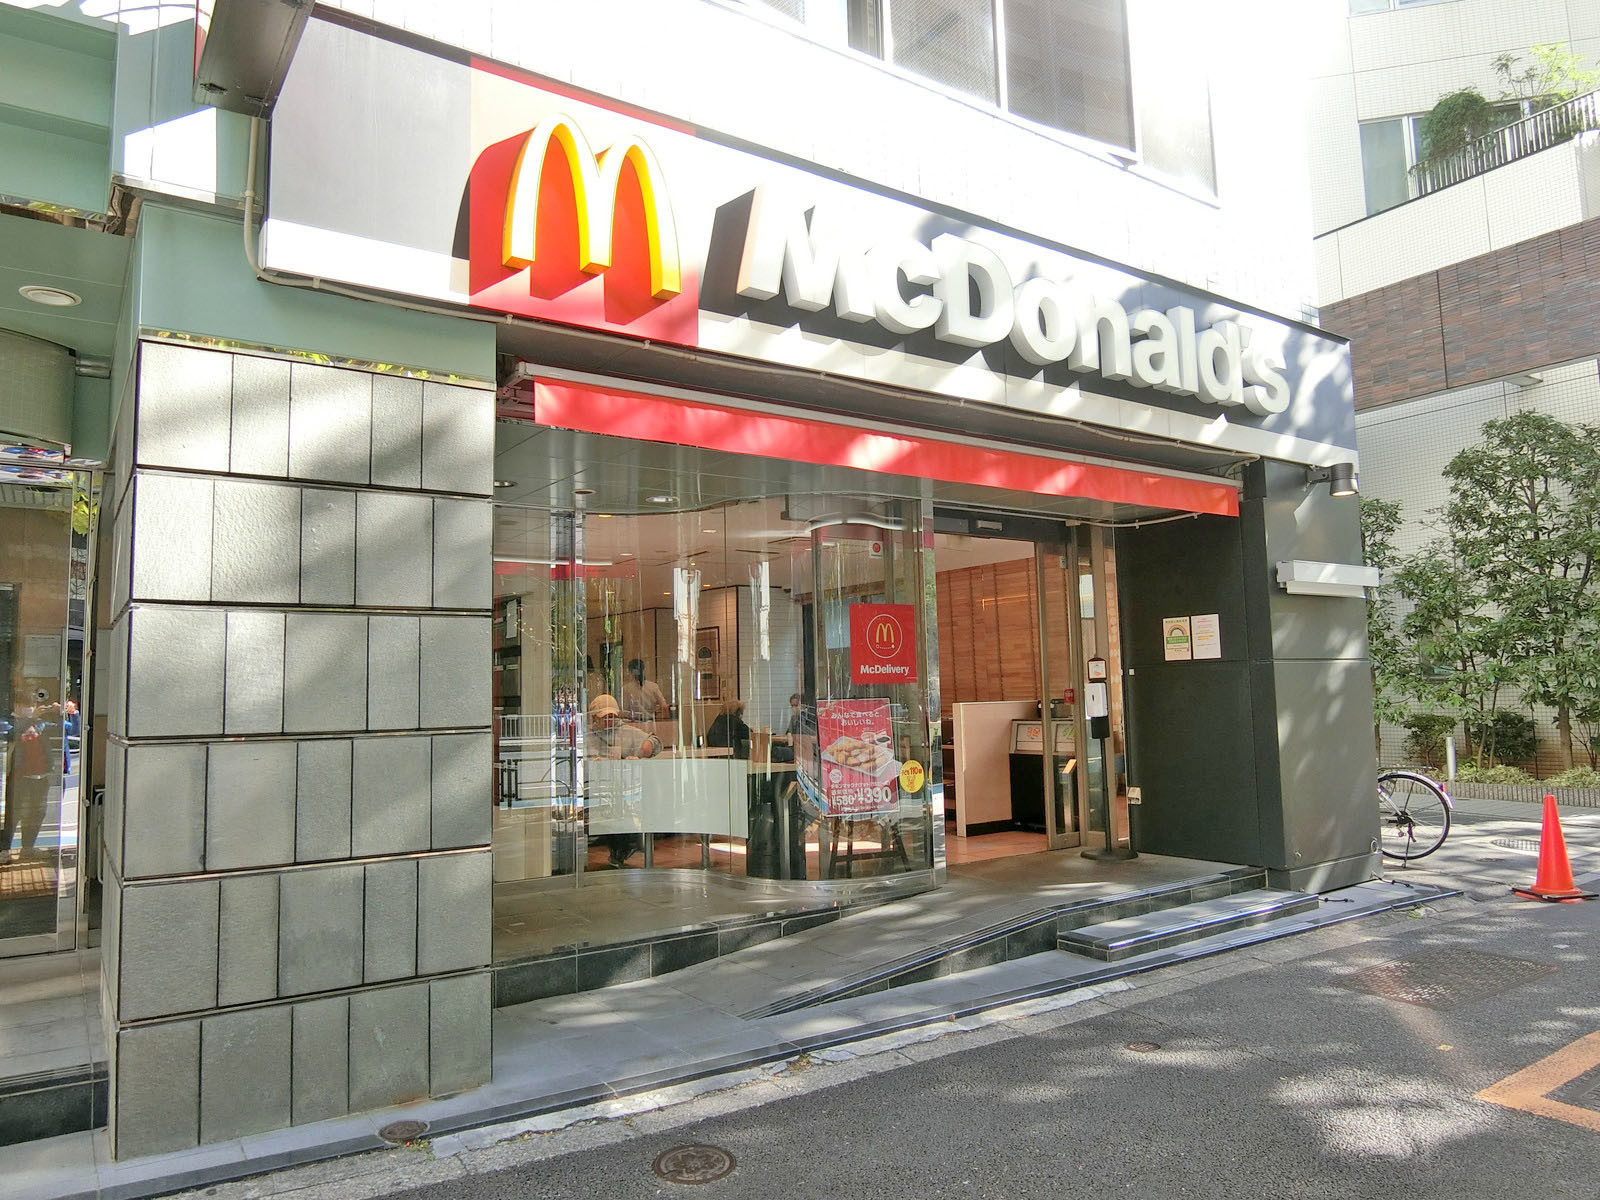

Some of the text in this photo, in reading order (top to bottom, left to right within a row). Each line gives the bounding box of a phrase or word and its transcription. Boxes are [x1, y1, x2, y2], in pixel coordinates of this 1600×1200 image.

[735, 182, 1292, 418] McDonald's
[860, 664, 910, 676] McDelivery
[857, 786, 892, 804] ¥390
